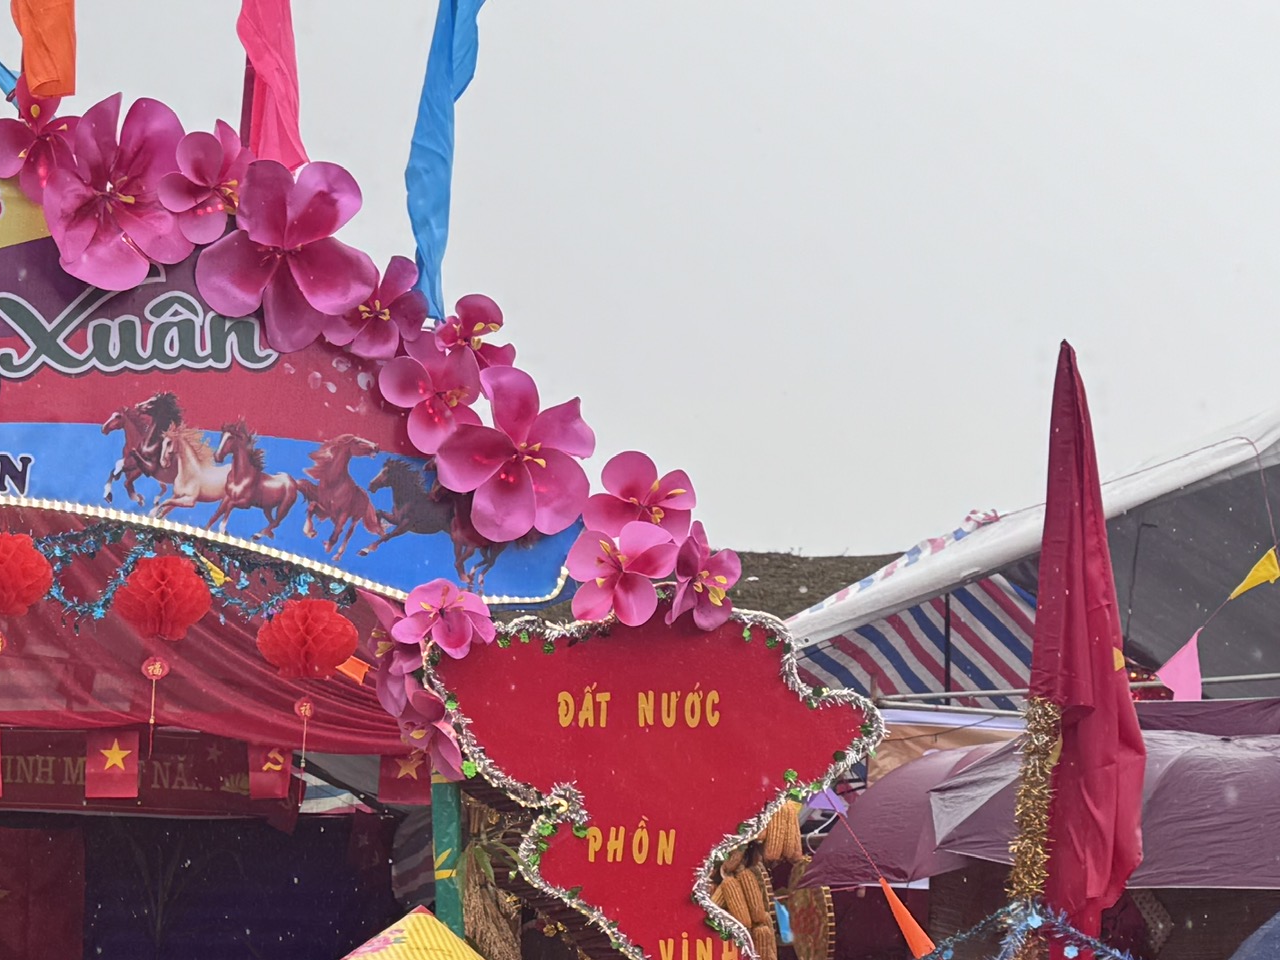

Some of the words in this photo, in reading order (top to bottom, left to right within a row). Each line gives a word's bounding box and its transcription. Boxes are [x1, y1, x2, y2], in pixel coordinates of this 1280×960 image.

[557, 682, 612, 728] ĐẤT
[638, 682, 721, 728] NƯỚC
[586, 816, 676, 865] PHỒN
